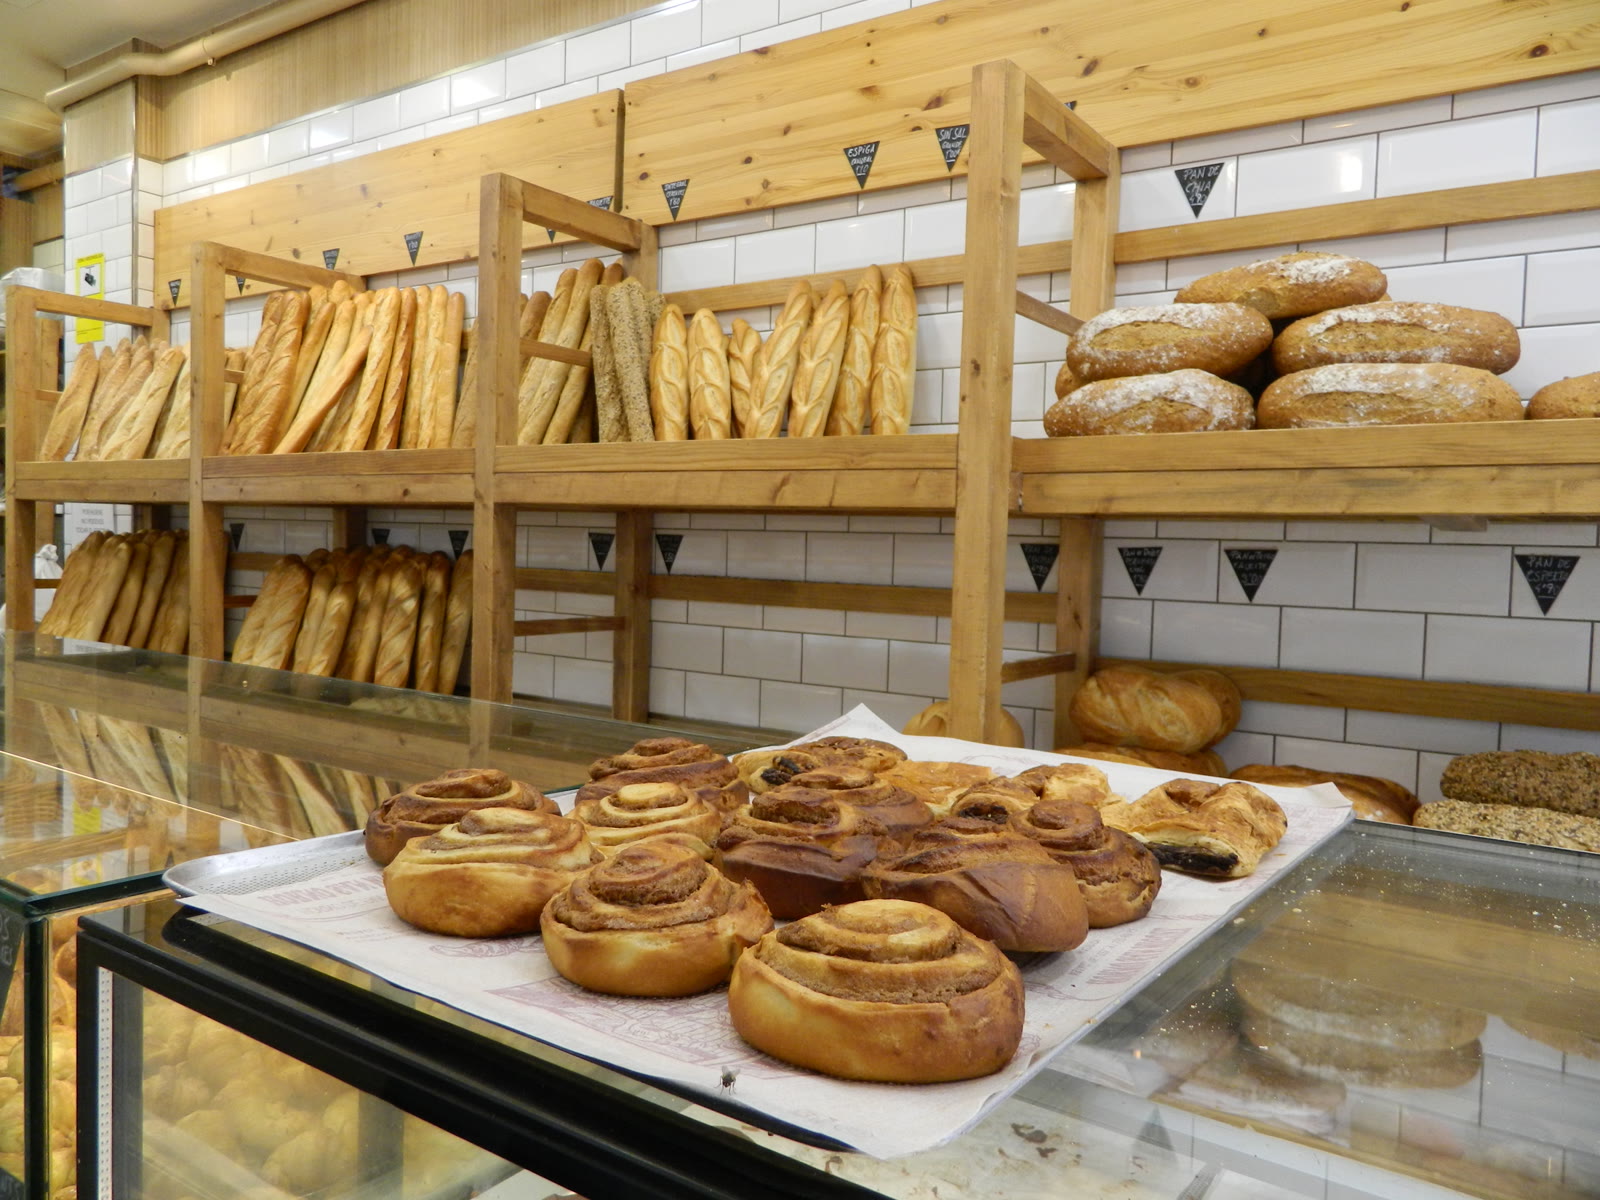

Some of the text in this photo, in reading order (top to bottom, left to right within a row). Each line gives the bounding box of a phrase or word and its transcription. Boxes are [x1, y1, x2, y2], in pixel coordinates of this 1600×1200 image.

[939, 128, 966, 141] SIN SAL
[848, 144, 875, 157] ESPIGA
[1184, 165, 1220, 180] PAN DE
[1185, 181, 1211, 193] CHIA
[1527, 556, 1571, 568] PAN DE
